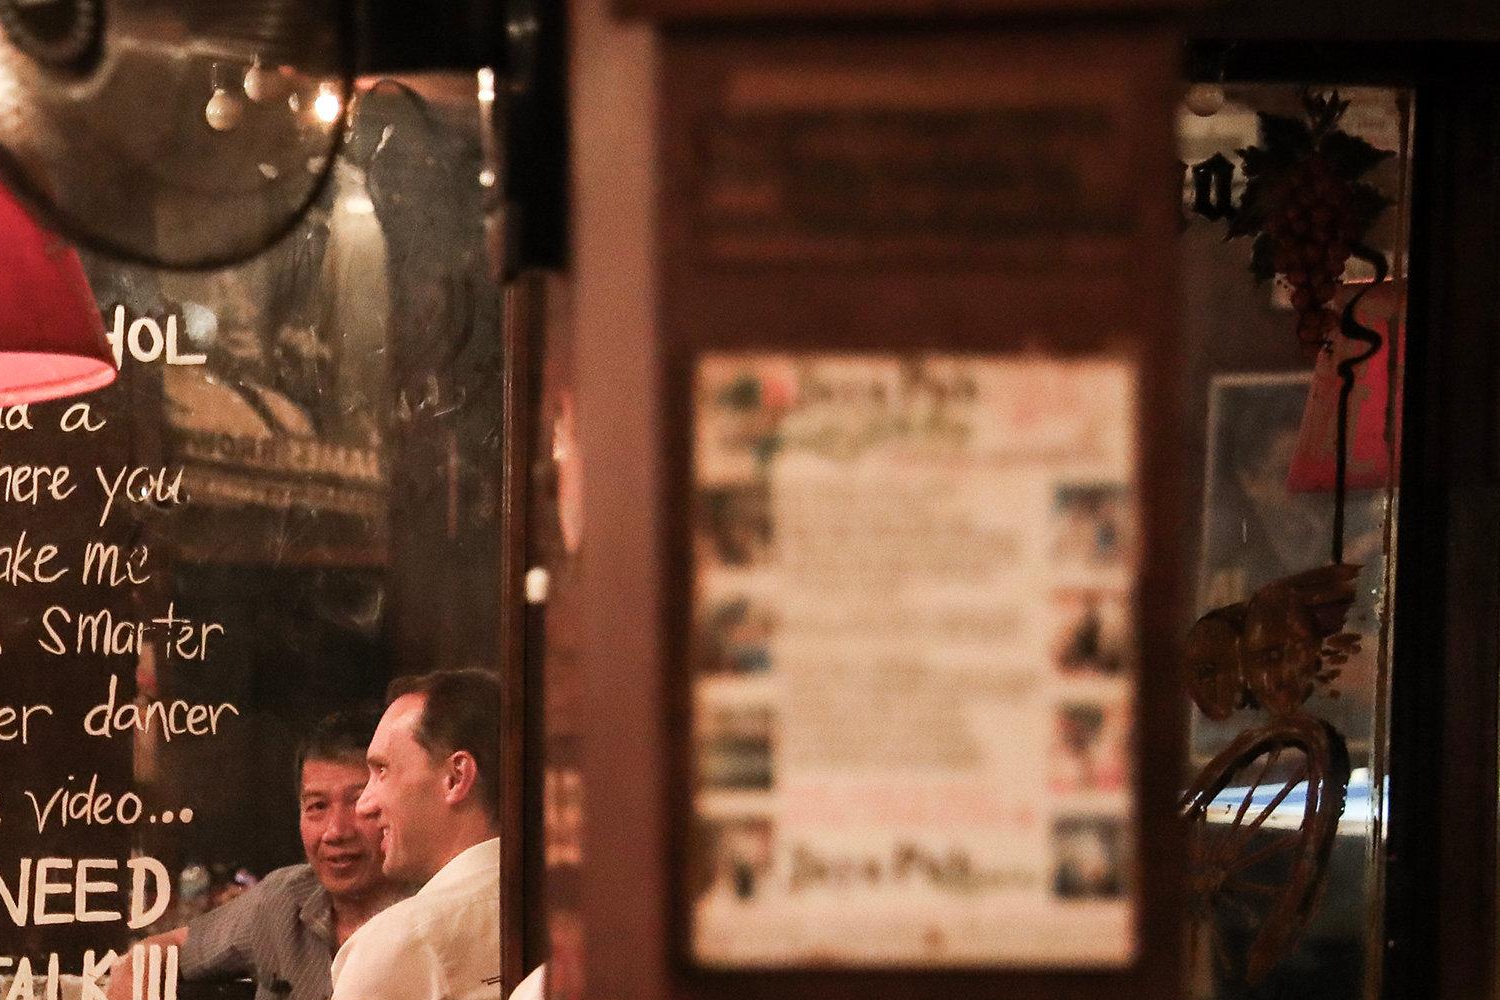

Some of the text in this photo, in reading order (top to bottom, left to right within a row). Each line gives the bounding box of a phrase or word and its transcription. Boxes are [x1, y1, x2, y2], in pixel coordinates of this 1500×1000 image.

[60, 402, 107, 433] a
[96, 466, 186, 527] you
[82, 542, 151, 586] me
[83, 675, 240, 743] dancer
